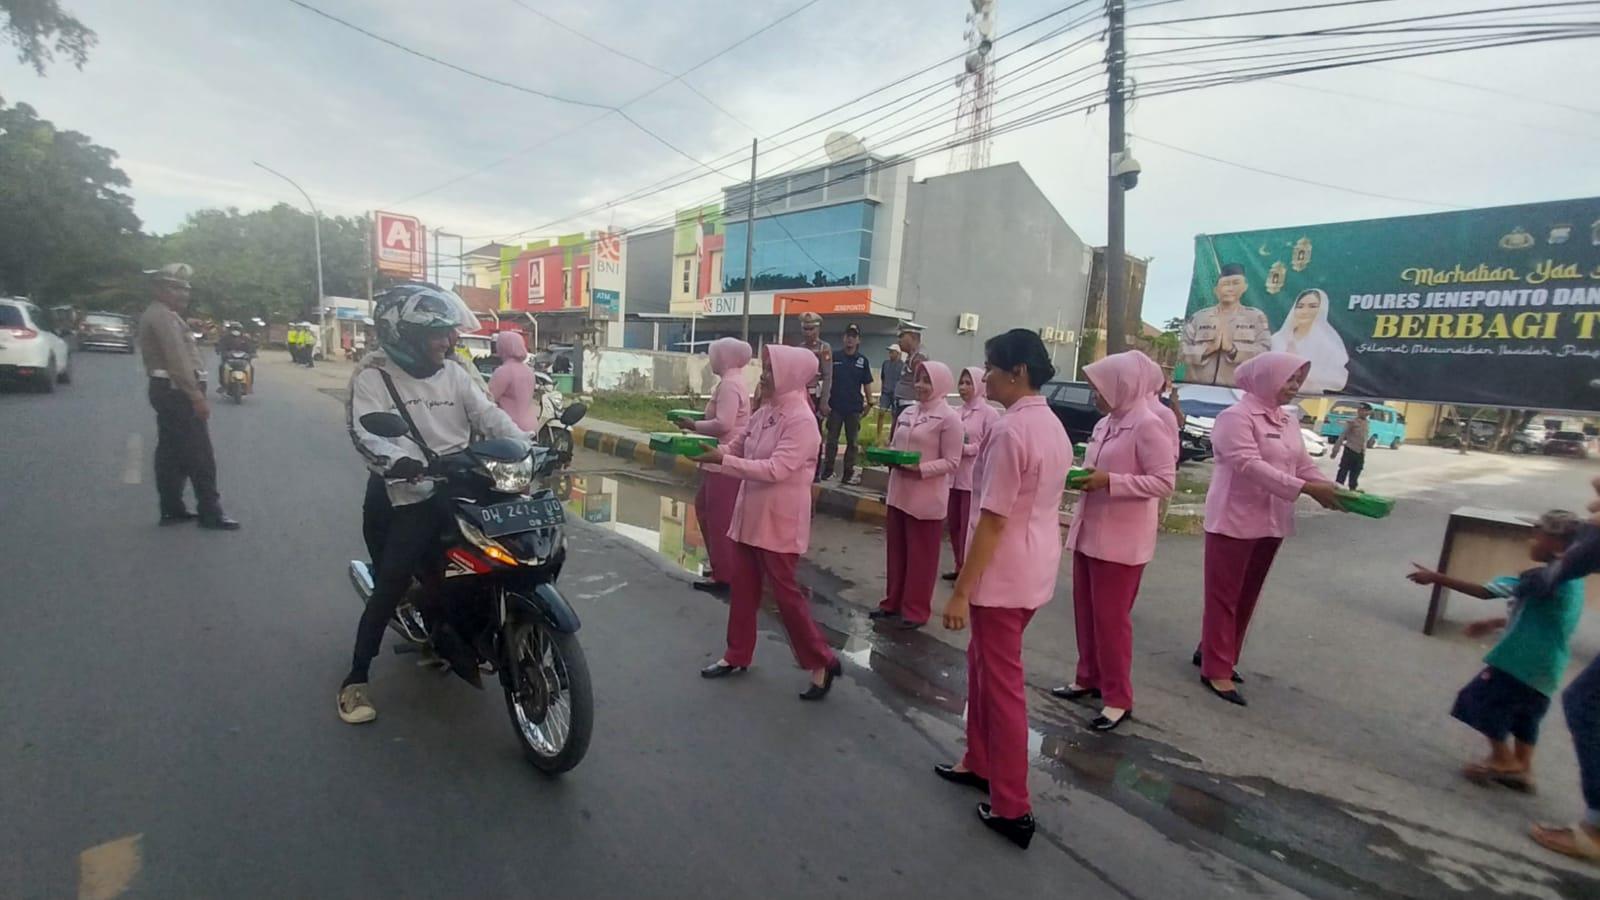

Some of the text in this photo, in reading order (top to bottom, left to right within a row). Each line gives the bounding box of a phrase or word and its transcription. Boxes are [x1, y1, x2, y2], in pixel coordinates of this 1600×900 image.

[597, 261, 620, 275] BNI
[1526, 259, 1583, 284] Yaa
[716, 297, 737, 312] BNI
[1348, 287, 1600, 310] POLRES JENEPONTO DAN
[1371, 312, 1561, 338] BERBAGI
